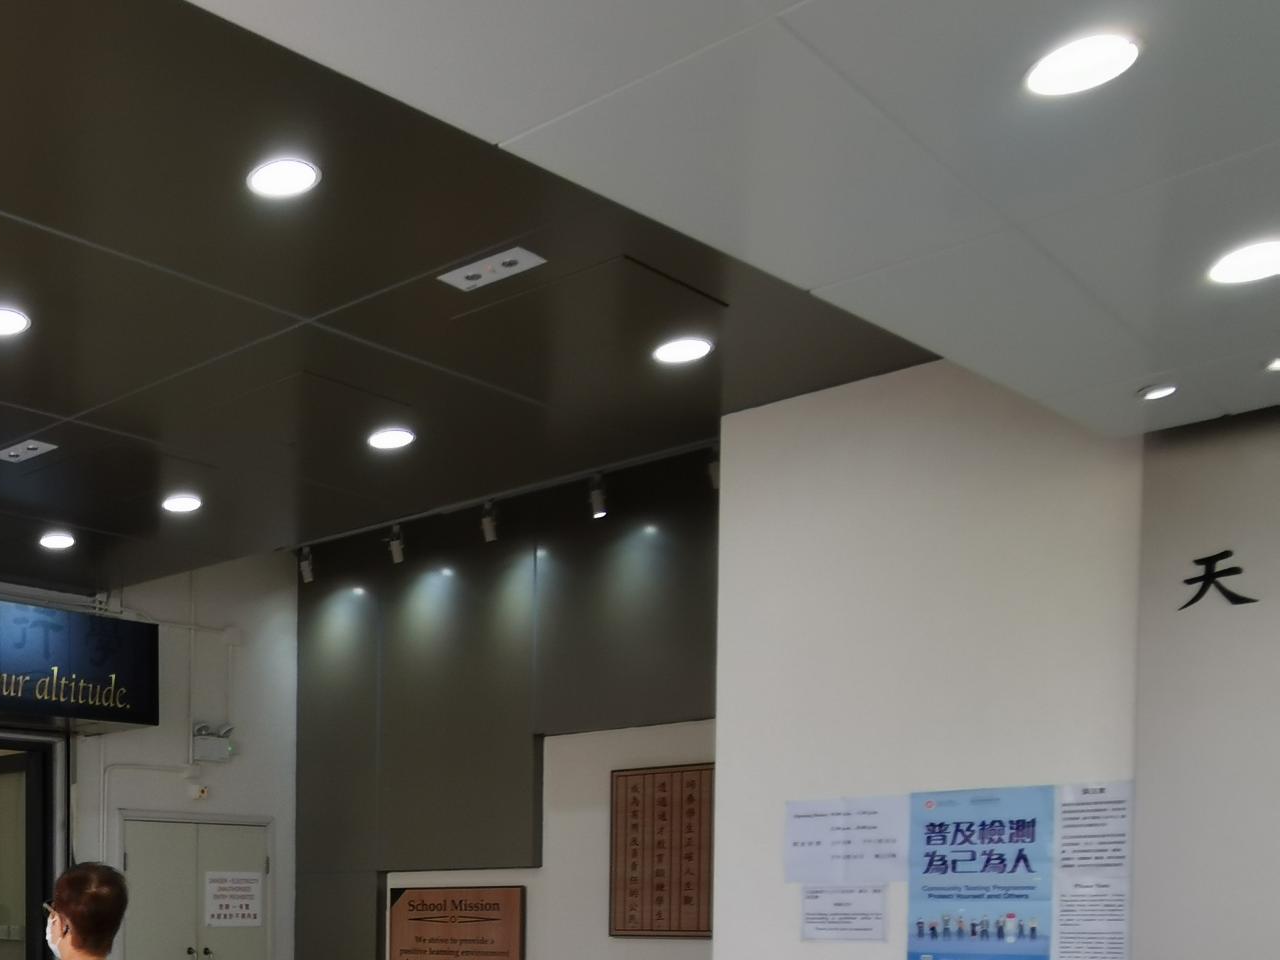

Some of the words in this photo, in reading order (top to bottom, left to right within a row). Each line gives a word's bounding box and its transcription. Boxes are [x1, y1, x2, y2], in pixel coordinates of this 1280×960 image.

[1177, 550, 1260, 611] 天
[34, 666, 131, 710] altitude.
[923, 818, 1037, 846] 普及檢測
[922, 847, 1038, 874] 為己為人
[407, 899, 447, 912] School
[450, 899, 501, 912] Mission
